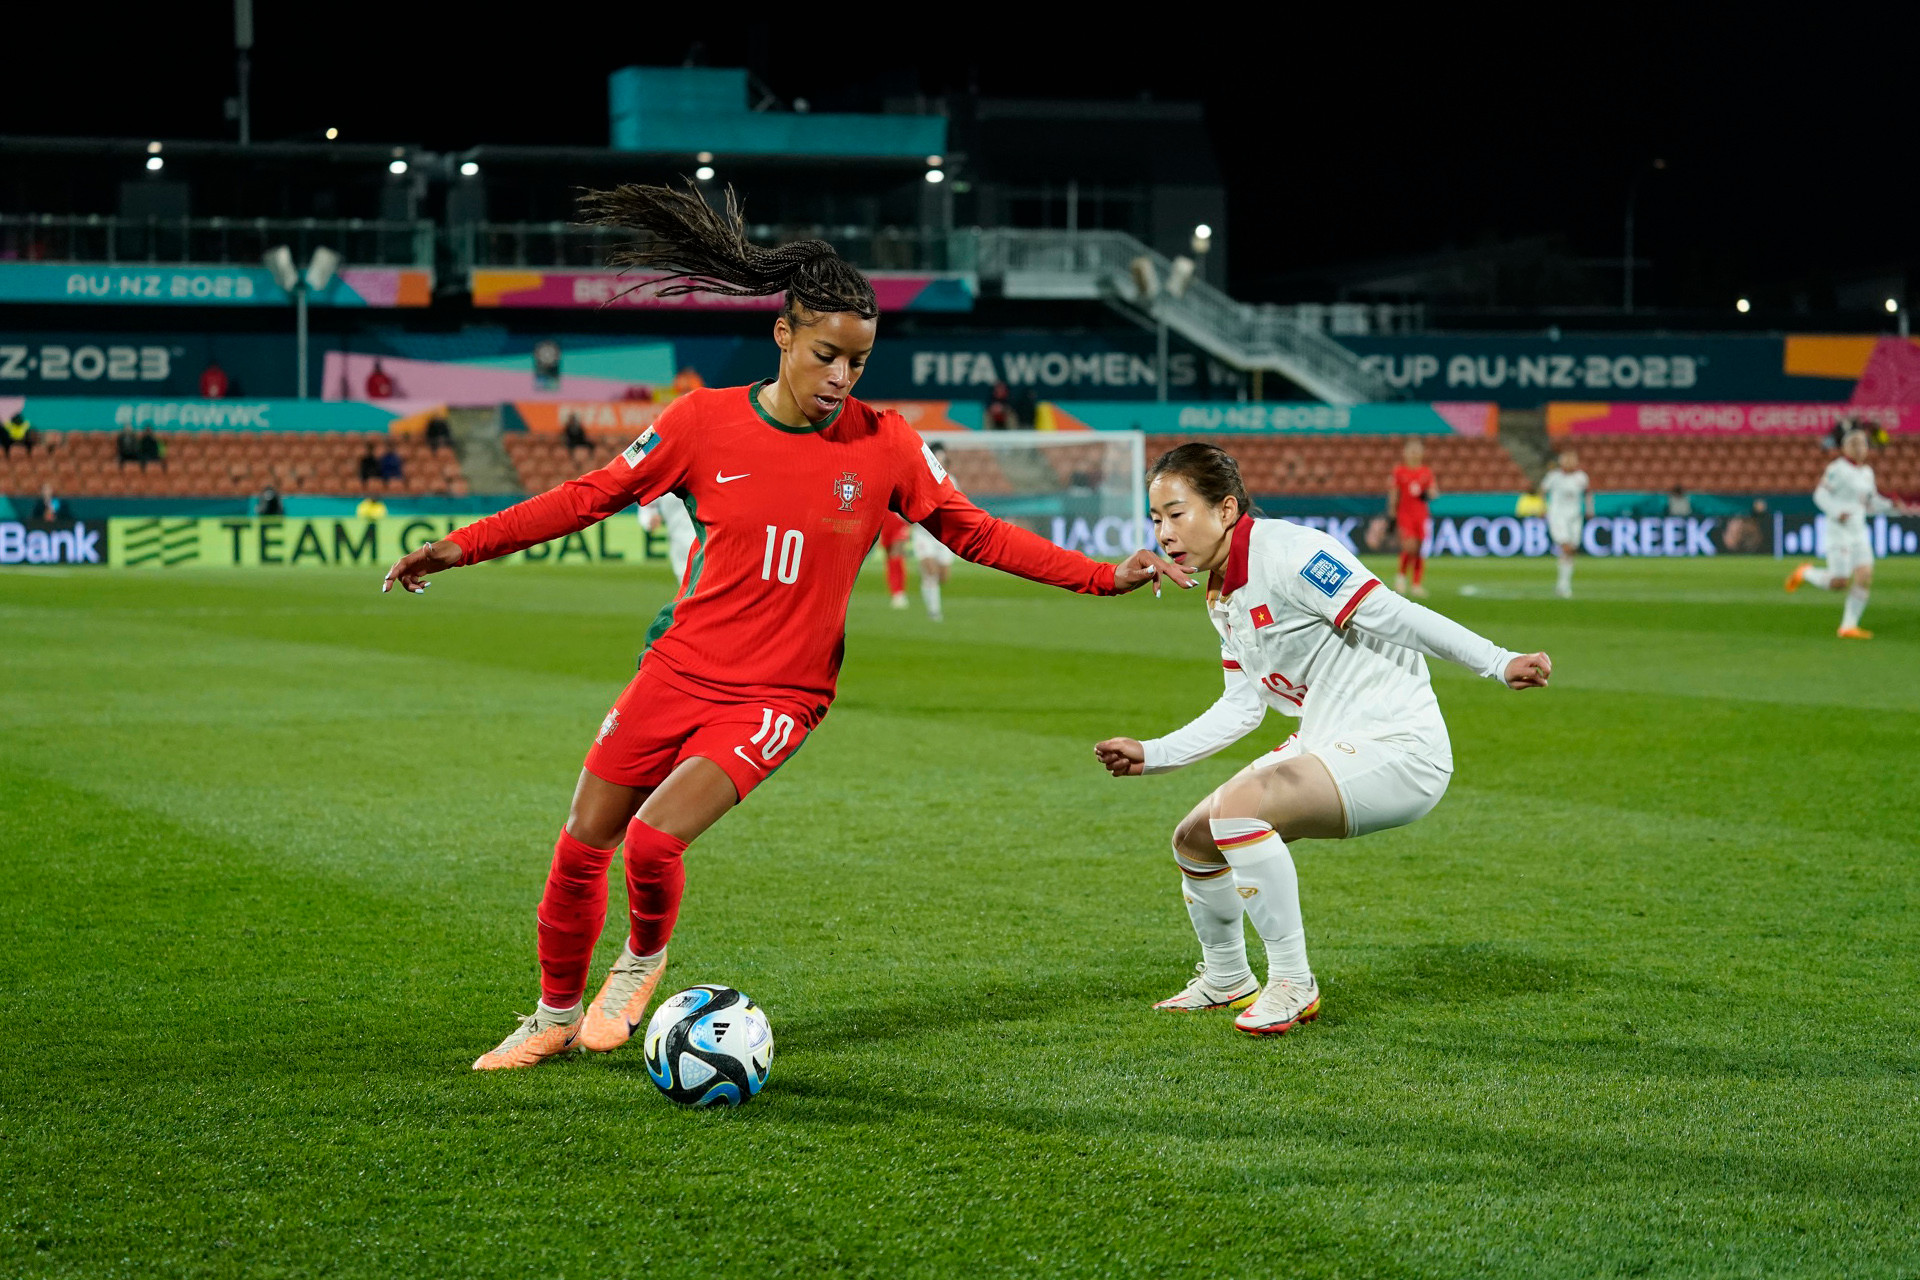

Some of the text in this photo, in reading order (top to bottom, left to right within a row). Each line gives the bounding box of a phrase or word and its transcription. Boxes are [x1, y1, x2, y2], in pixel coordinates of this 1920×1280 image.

[169, 274, 254, 298] 2023
[911, 352, 998, 386] FIFA
[1002, 352, 1198, 387] WOMENS
[1637, 404, 1746, 430] BEYOND
[0, 520, 100, 564] Bank
[219, 519, 379, 565] TEAM
[400, 520, 623, 561] GAL
[761, 525, 804, 584] 10
[1420, 516, 1718, 557] JACOB CREEK
[749, 706, 796, 762] 10
